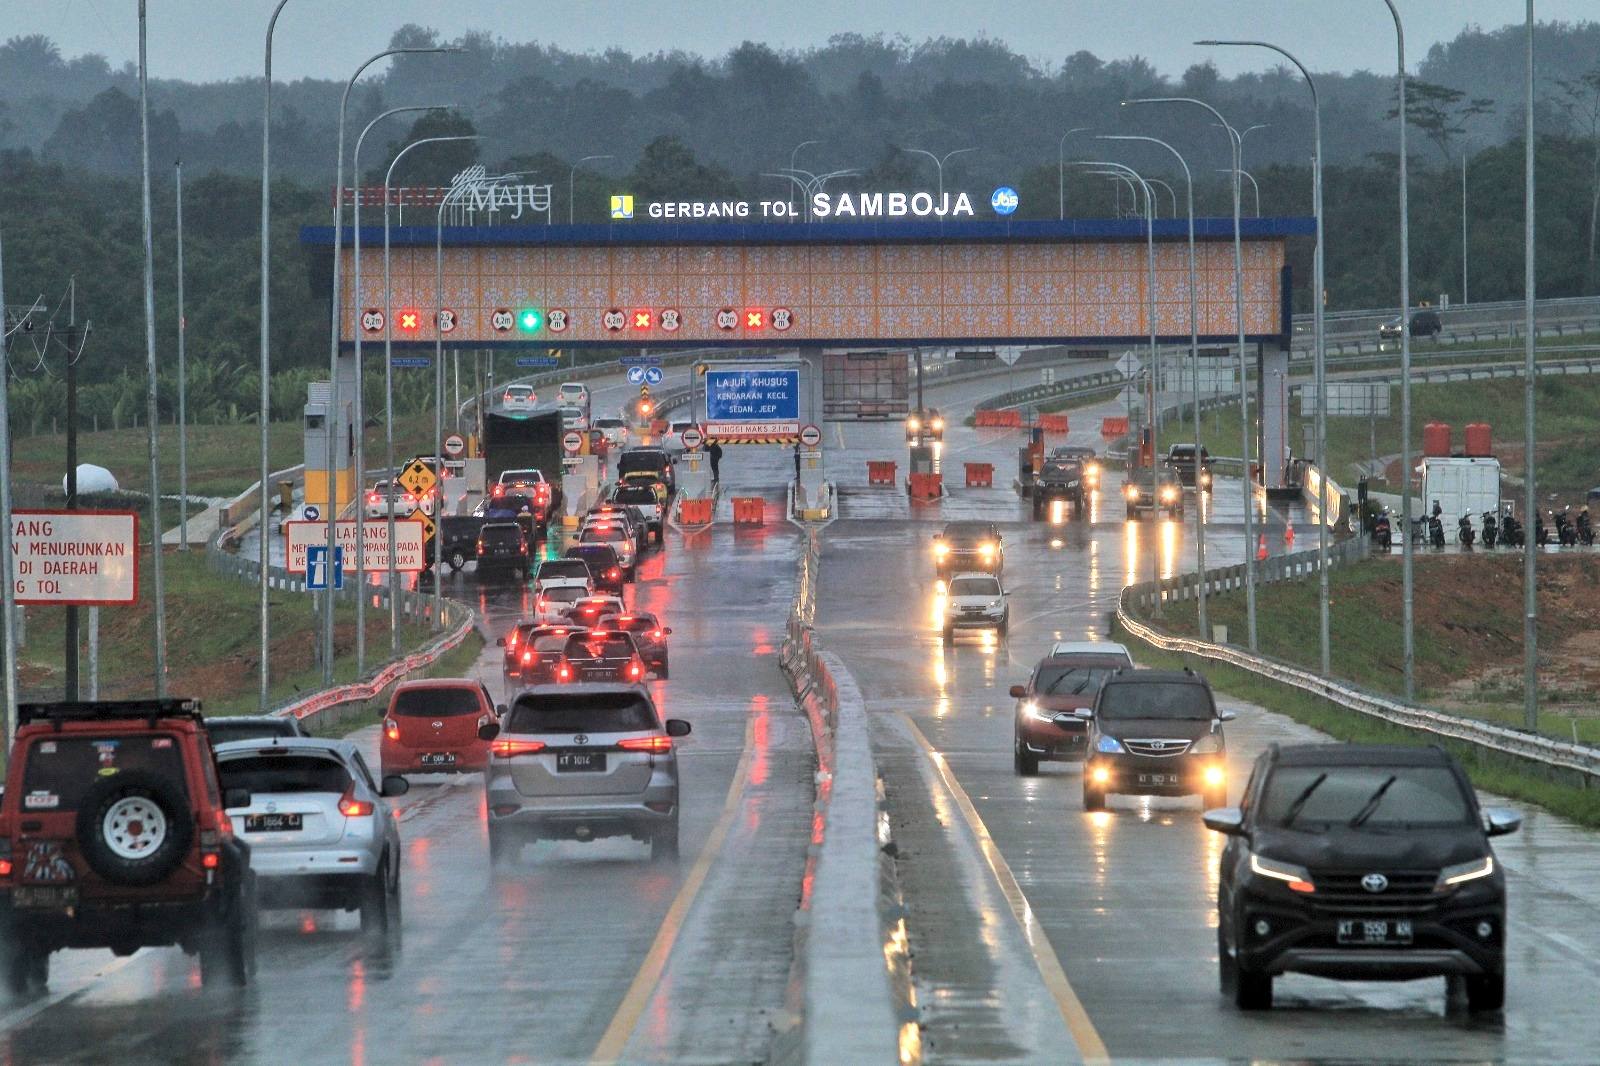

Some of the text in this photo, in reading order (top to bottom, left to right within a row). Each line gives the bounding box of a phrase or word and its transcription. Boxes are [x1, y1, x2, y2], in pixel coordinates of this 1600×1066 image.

[466, 184, 553, 219] MAJU
[648, 192, 975, 218] GERBANG TOL SAMBOJA
[716, 377, 788, 387] LAJUR KHUSUS
[717, 392, 763, 400] KENDARAAN
[759, 405, 777, 413] JEEP
[30, 542, 124, 556] MENURUNKAN
[397, 541, 419, 552] PADA
[20, 560, 98, 575] DI DAERAH
[37, 580, 62, 594] TOL
